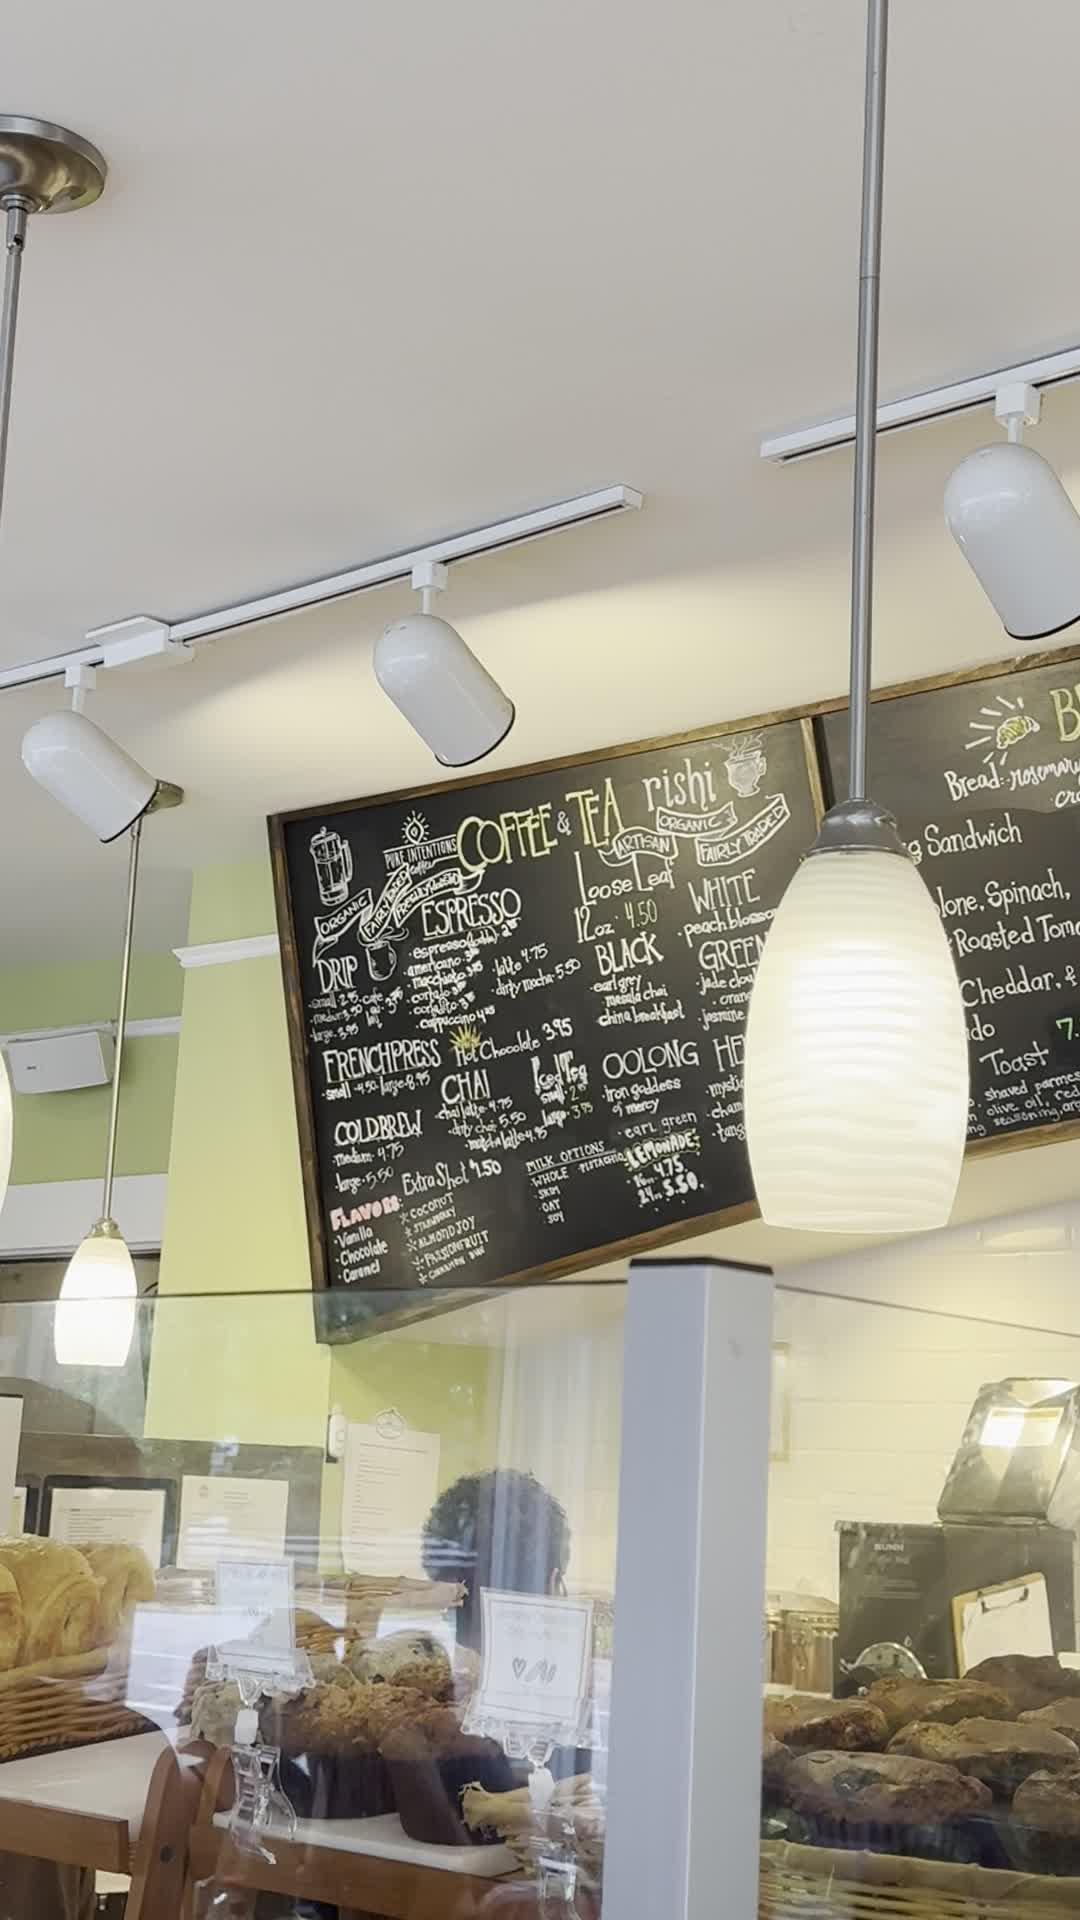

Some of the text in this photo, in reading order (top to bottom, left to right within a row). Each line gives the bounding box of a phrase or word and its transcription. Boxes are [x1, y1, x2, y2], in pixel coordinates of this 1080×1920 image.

[641, 758, 717, 812] rishi
[943, 761, 1004, 801] Bread:
[457, 778, 625, 873] COFFEE & TEA
[659, 815, 722, 832] ORGANIC
[699, 804, 785, 863] FAIRLY TRADED
[924, 812, 1023, 857] Sandwich
[384, 838, 457, 870] PURE INTENTIONS
[615, 833, 671, 858] ARTISAN
[573, 850, 676, 906] Loose Leaf
[687, 867, 761, 915] WHITE
[985, 867, 1071, 915] Spinach,
[320, 894, 369, 934] ORGANIC
[364, 896, 392, 938] FAIRLY
[422, 887, 522, 937] ESPRESSO
[623, 898, 658, 929] 4.50
[683, 909, 728, 948] peach
[953, 915, 1035, 957] Roasted
[495, 943, 549, 977] latte 4.75
[594, 930, 665, 976] BLACK
[698, 930, 768, 973] GREEN
[317, 954, 358, 995] DRIP
[495, 958, 582, 999] dirty mocha 5.50
[593, 974, 642, 993] earl grey
[700, 971, 728, 996] jade
[960, 964, 1062, 1008] Cheddar,
[642, 982, 669, 1001] chai
[420, 1014, 476, 1034] cappuccino
[597, 999, 686, 1027] china breakfast
[701, 1006, 746, 1031] jasmine
[453, 1017, 573, 1068] Hot Chocolate 3.95
[979, 1040, 1050, 1076] Toast
[602, 1038, 700, 1080] OOLONG
[326, 1081, 352, 1101] small
[379, 1075, 406, 1097] large
[440, 1068, 491, 1105] CHAI
[604, 1076, 682, 1103] iron goddess
[984, 1079, 1029, 1102] shaved
[498, 1111, 527, 1128] 5.50
[624, 1097, 660, 1115] mercy
[986, 1101, 1019, 1117] olive
[660, 1111, 698, 1135] green
[334, 1141, 405, 1167] medium 4.75
[525, 1140, 606, 1174] MILK OPTIONS
[579, 1152, 625, 1174] PISTACHIO
[625, 1131, 696, 1169] LEMONADE
[336, 1172, 362, 1195] large
[401, 1170, 436, 1196] Extra
[435, 1161, 470, 1191] Shot
[532, 1166, 570, 1188] WHOLE
[537, 1184, 561, 1200] SKIM
[409, 1191, 455, 1220] COCONUT
[541, 1199, 561, 1213] OAT
[547, 1210, 566, 1225] SOY
[336, 1225, 374, 1249] Vanilla
[418, 1215, 475, 1250] ALMOND JOY
[340, 1237, 389, 1266] Chocolate
[343, 1258, 381, 1283] Caramel
